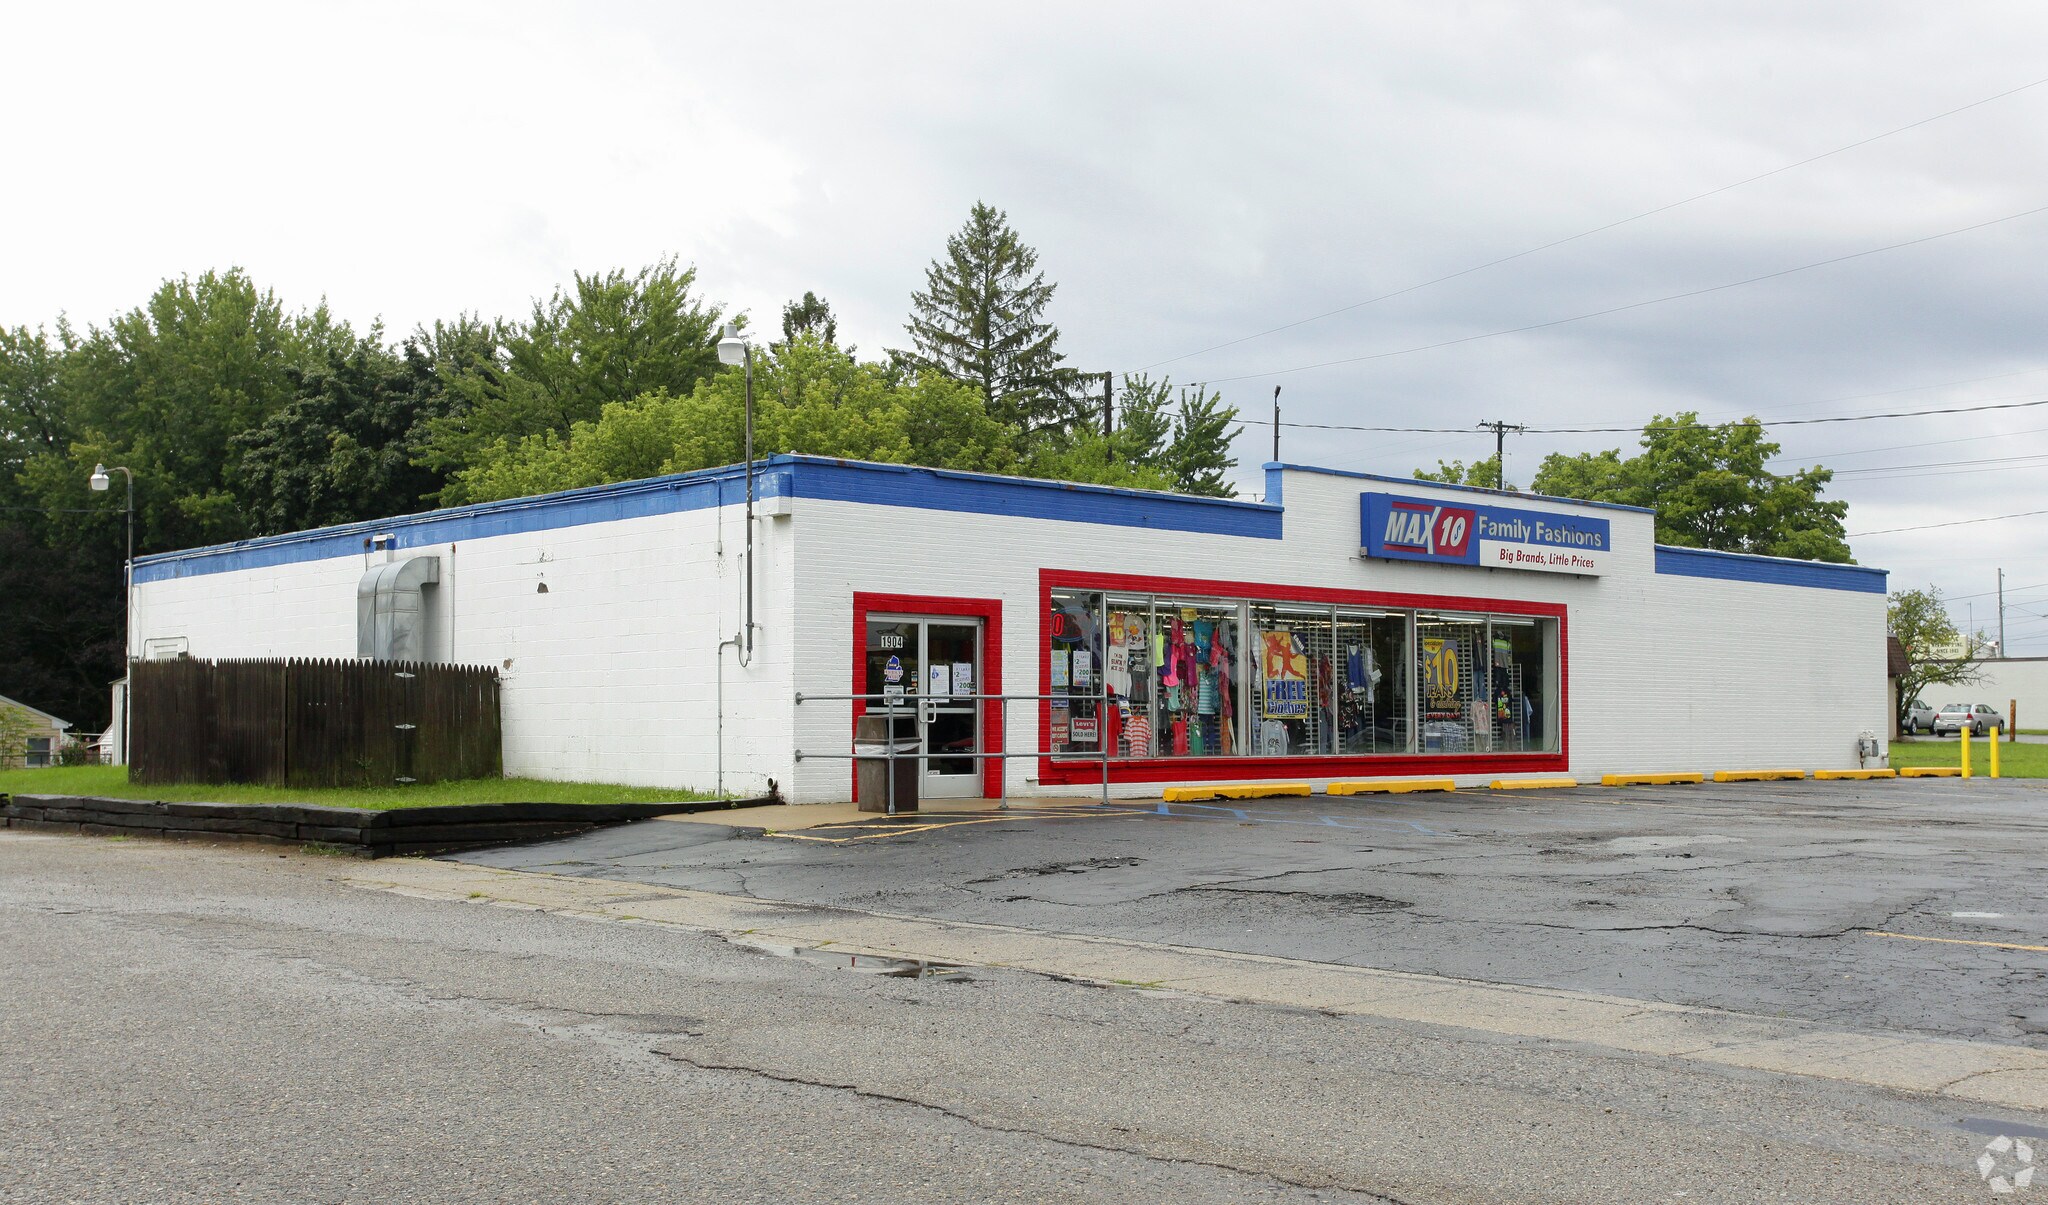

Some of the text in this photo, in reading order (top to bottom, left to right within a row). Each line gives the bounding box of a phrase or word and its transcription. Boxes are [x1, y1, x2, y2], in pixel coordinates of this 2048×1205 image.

[1384, 506, 1466, 554] MAX 10
[1479, 515, 1602, 547] Family Fashions
[1500, 548, 1594, 568] Big Brands, Little Prices
[882, 636, 903, 648] 1904
[1425, 648, 1459, 696] $10
[1266, 680, 1307, 700] FREE
[1427, 684, 1454, 699] JEANS
[1266, 701, 1307, 714] Clothes
